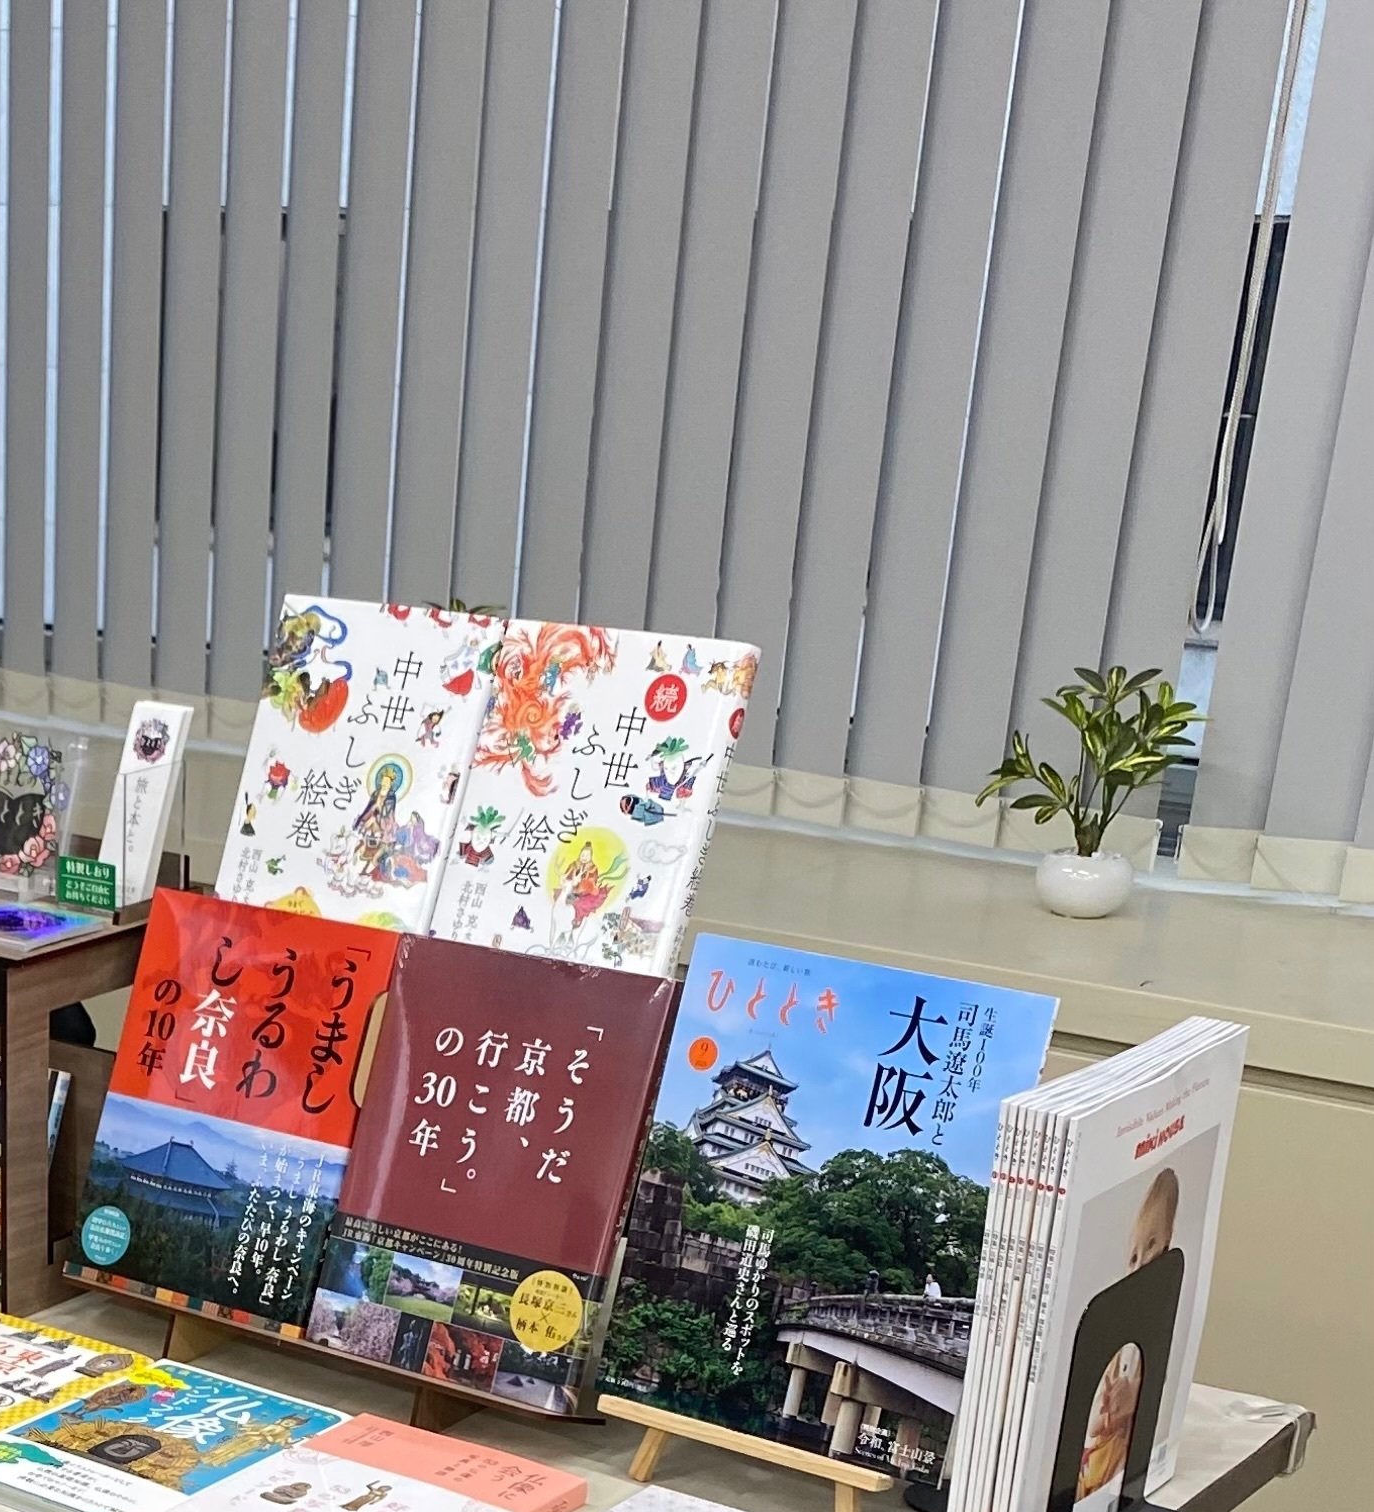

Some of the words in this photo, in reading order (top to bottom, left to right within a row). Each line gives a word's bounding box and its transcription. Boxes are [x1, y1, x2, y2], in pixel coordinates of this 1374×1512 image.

[380, 650, 424, 733] 中世
[652, 682, 679, 715] 続
[330, 694, 382, 812] ふしぎ
[555, 724, 607, 845] ふしぎ
[602, 705, 648, 791] 中世
[127, 776, 148, 853] 旅と本と。
[285, 767, 334, 850] 絵巻
[502, 813, 556, 896] 絵巻
[138, 978, 181, 1077] の10年
[173, 936, 242, 1104] し奈良」
[235, 948, 296, 1099] うるわ
[302, 946, 371, 1114] 「うまし
[707, 968, 840, 1034] ひととき
[408, 1026, 465, 1157] の30年
[503, 1039, 552, 1149] 京都、
[863, 995, 948, 1137] 大阪
[931, 1002, 979, 1146] 司馬遼太郎と
[967, 1007, 999, 1093] 生誕100年
[535, 1025, 605, 1185] 「そうだ
[731, 1228, 775, 1375] 司馬ゆかりのスポットを
[120, 1381, 225, 1429] ハンドブック
[144, 1388, 278, 1446] 仏像
[482, 1463, 528, 1484] 会う
[492, 1472, 554, 1502] 仏像に
